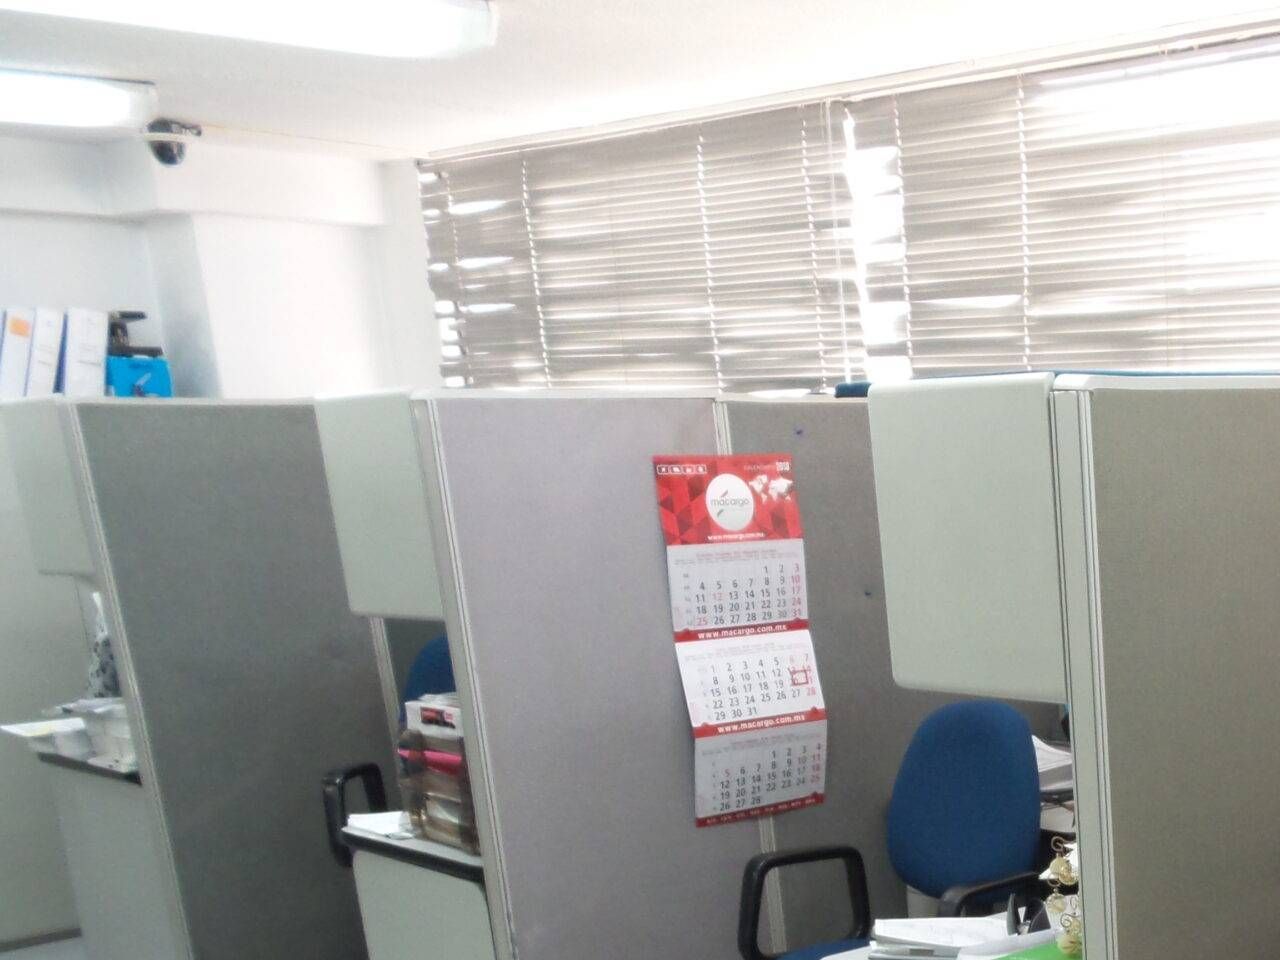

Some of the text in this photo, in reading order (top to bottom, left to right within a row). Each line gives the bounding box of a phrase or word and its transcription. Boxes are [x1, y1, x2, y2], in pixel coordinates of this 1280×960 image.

[710, 496, 749, 507] macargo
[779, 564, 784, 572] 2
[700, 582, 705, 590] 4
[717, 581, 721, 589] 5
[732, 579, 738, 587] 6
[749, 578, 753, 586] 7
[780, 576, 784, 584] 9
[791, 575, 800, 583] 10
[714, 593, 723, 601] 12
[761, 589, 770, 597] 15
[777, 588, 786, 596] 16
[696, 598, 801, 614] 18 19 20 21 22 23 24
[697, 617, 707, 626] 25
[714, 616, 724, 625] 26
[730, 615, 740, 624] 27
[746, 613, 756, 622] 28
[762, 612, 772, 620] 29
[727, 663, 732, 671] 2
[743, 661, 748, 669] 3
[758, 659, 764, 667] 4
[774, 658, 779, 666] 5
[712, 677, 718, 685] 8
[729, 674, 734, 683] 9
[741, 673, 750, 681] 10
[756, 671, 765, 679] 11
[772, 669, 781, 677] 12
[711, 689, 721, 697] 15
[727, 686, 737, 695] 16
[743, 684, 753, 693] 17
[759, 682, 768, 690] 18
[774, 679, 784, 689] 19
[712, 687, 816, 709] 22 23 24 25 26 27 28
[714, 707, 757, 721] 29 30 31
[787, 748, 791, 756] 2
[725, 769, 730, 777] 5
[756, 763, 760, 772] 7
[772, 761, 776, 769] 8
[787, 759, 791, 767] 9
[798, 756, 807, 764] 10
[721, 781, 729, 789] 12
[736, 778, 745, 786] 13
[751, 775, 760, 784] 14
[767, 772, 776, 780] 15
[782, 769, 791, 778] 16
[797, 766, 805, 775] 17
[721, 791, 730, 800] 19
[736, 789, 746, 797] 20
[751, 786, 760, 794] 21
[766, 783, 776, 791] 22
[782, 780, 791, 789] 23
[796, 777, 805, 786] 24
[720, 796, 761, 811] 26 27 28
